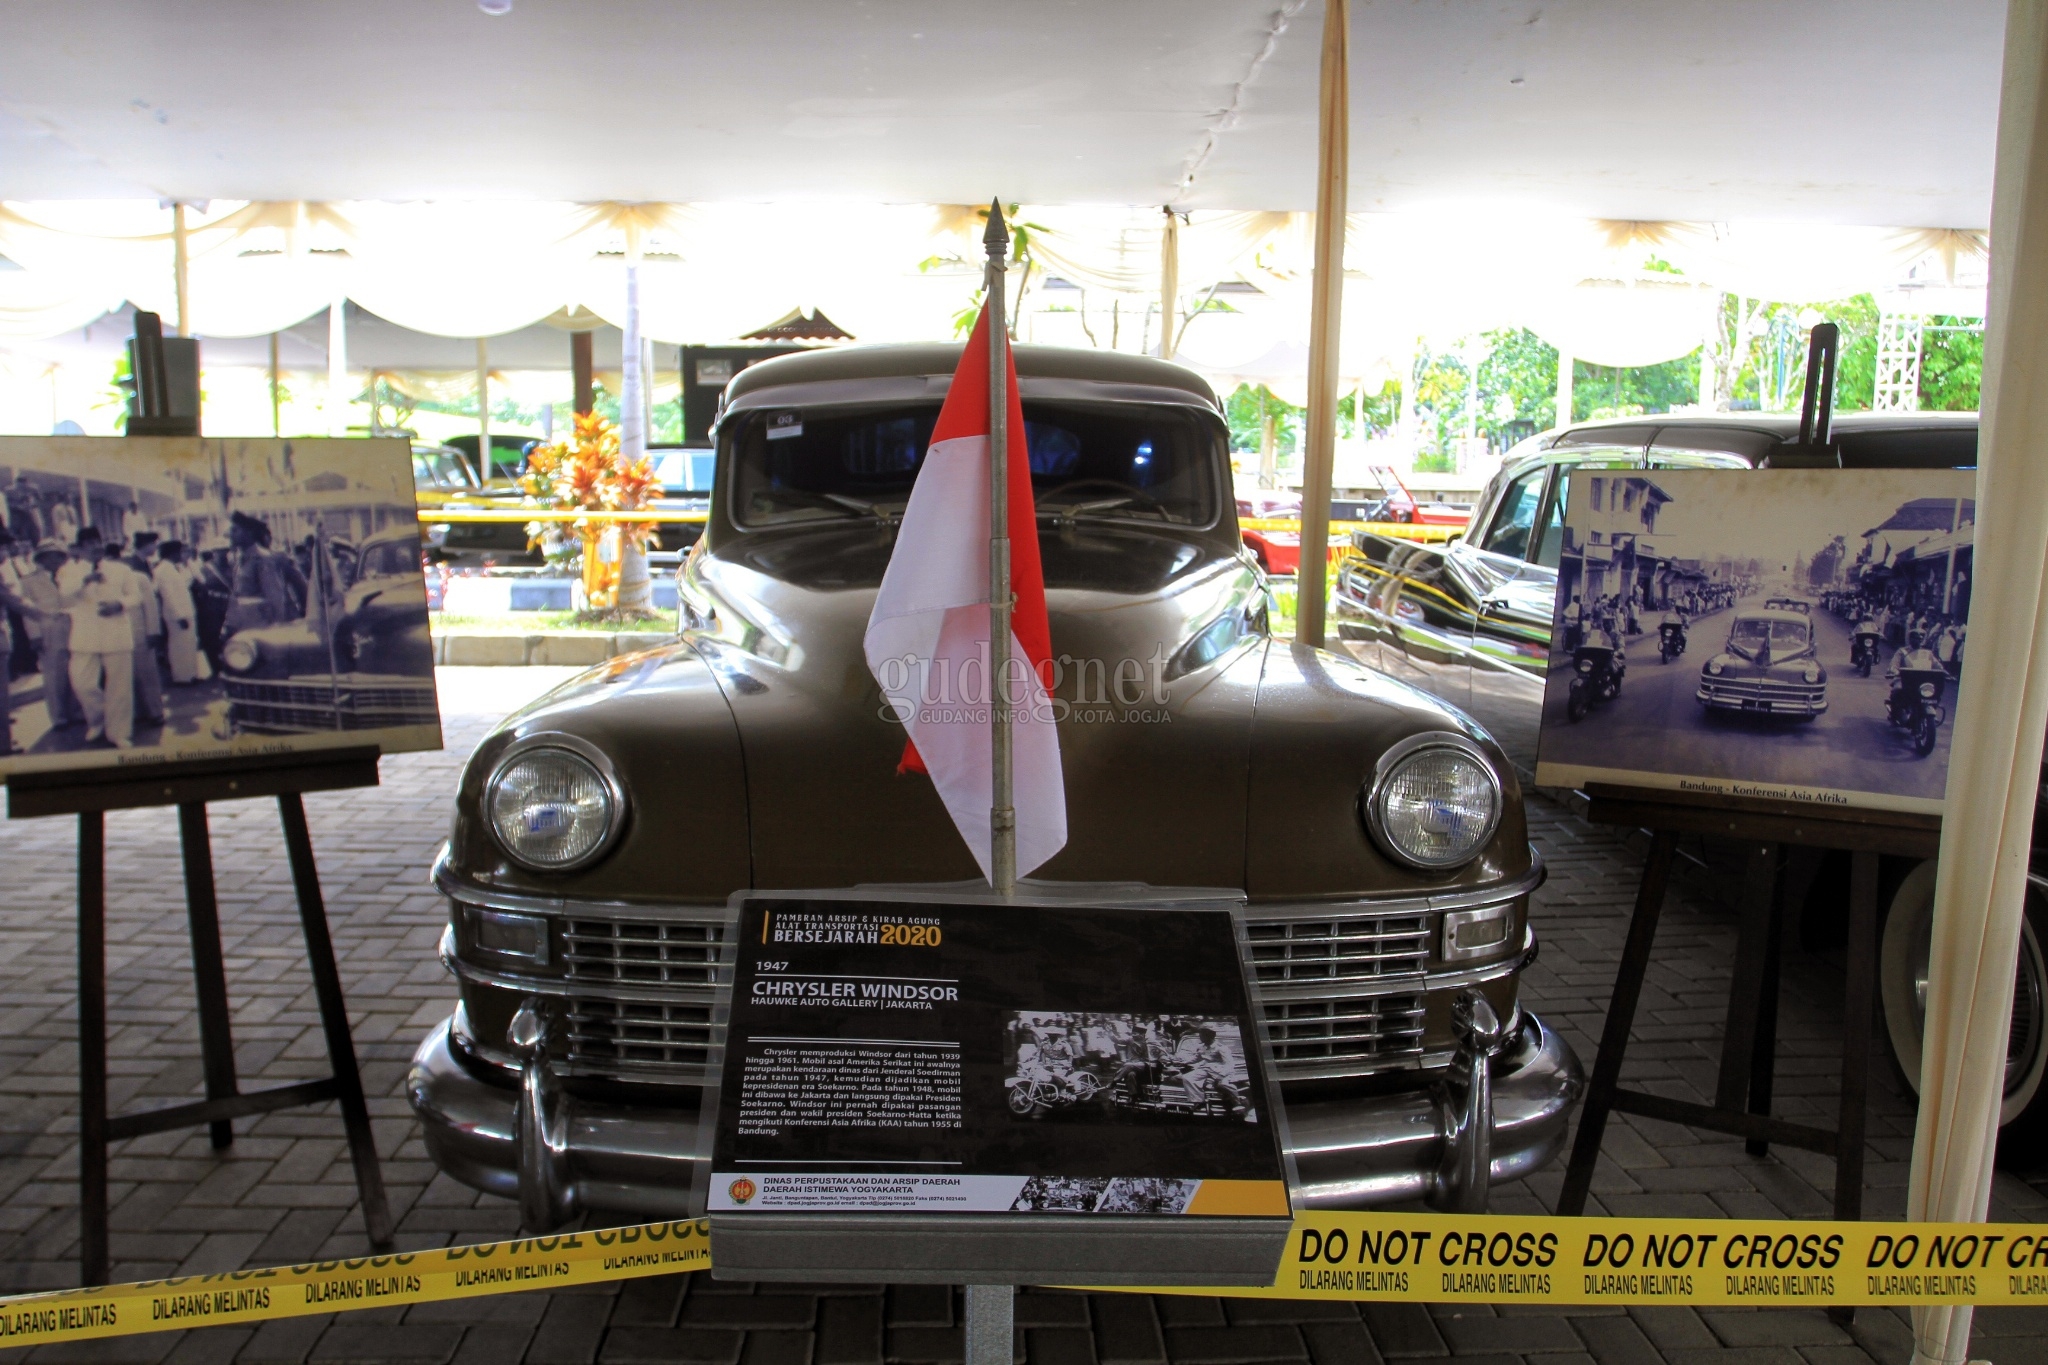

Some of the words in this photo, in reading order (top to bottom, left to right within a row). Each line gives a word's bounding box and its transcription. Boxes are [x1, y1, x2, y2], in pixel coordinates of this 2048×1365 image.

[1681, 780, 1723, 794] Bandung
[1733, 785, 1786, 798] Konferensi
[1790, 791, 1811, 801] Asia
[1815, 793, 1847, 804] Afrika
[777, 914, 823, 922] PAMERAN
[908, 917, 940, 925] AGUNG
[774, 930, 878, 944] BERSEJARAH
[880, 924, 942, 947] 2020
[756, 961, 788, 971] 1947
[752, 981, 856, 998] CHRYSLER
[861, 984, 958, 1001] WINDSOR
[751, 997, 797, 1006] HAUWKE
[800, 998, 830, 1007] AUTO
[832, 999, 878, 1008] GALLERY
[886, 1000, 932, 1010] JAKARTA
[885, 1076, 929, 1084] dijadikan
[852, 1093, 889, 1101] langsung
[882, 1102, 914, 1110] dipakai
[739, 1118, 782, 1126] mengikuti
[740, 1109, 776, 1117] presiden
[827, 1110, 862, 1118] presiden
[794, 1177, 868, 1185] PERPUSTAKAAN
[662, 1249, 710, 1263] MELINTA
[1299, 1228, 1349, 1264] DO
[1358, 1229, 1431, 1265] NOT
[1439, 1232, 1558, 1267] CROSS
[1583, 1233, 1634, 1268] DO
[1643, 1234, 1717, 1268] NOT
[1723, 1234, 1844, 1269] CROSS
[1866, 1235, 1919, 1268] DO
[1925, 1236, 2004, 1268] NOT
[306, 1279, 362, 1303] DILARANG
[366, 1275, 420, 1297] MELINTAS
[1300, 1270, 1352, 1291] DILARANG
[1357, 1272, 1408, 1292] MELINTAS
[1442, 1273, 1495, 1293] DILARANG
[1500, 1273, 1550, 1294] MELINTAS
[1584, 1274, 1637, 1295] DILARANG
[1641, 1275, 1693, 1296] MELINTAS
[1726, 1275, 1779, 1295] DILARANG
[1783, 1275, 1834, 1296] MELINTAS
[1868, 1275, 1921, 1295] DILARANG
[1924, 1275, 1976, 1295] MELINTAS
[2009, 1275, 2048, 1295] DILARA
[153, 1293, 211, 1320] DILARANG
[214, 1287, 270, 1314] MELINTAS
[0, 1310, 56, 1336] DILARANG
[59, 1304, 116, 1330] MELINTAS
